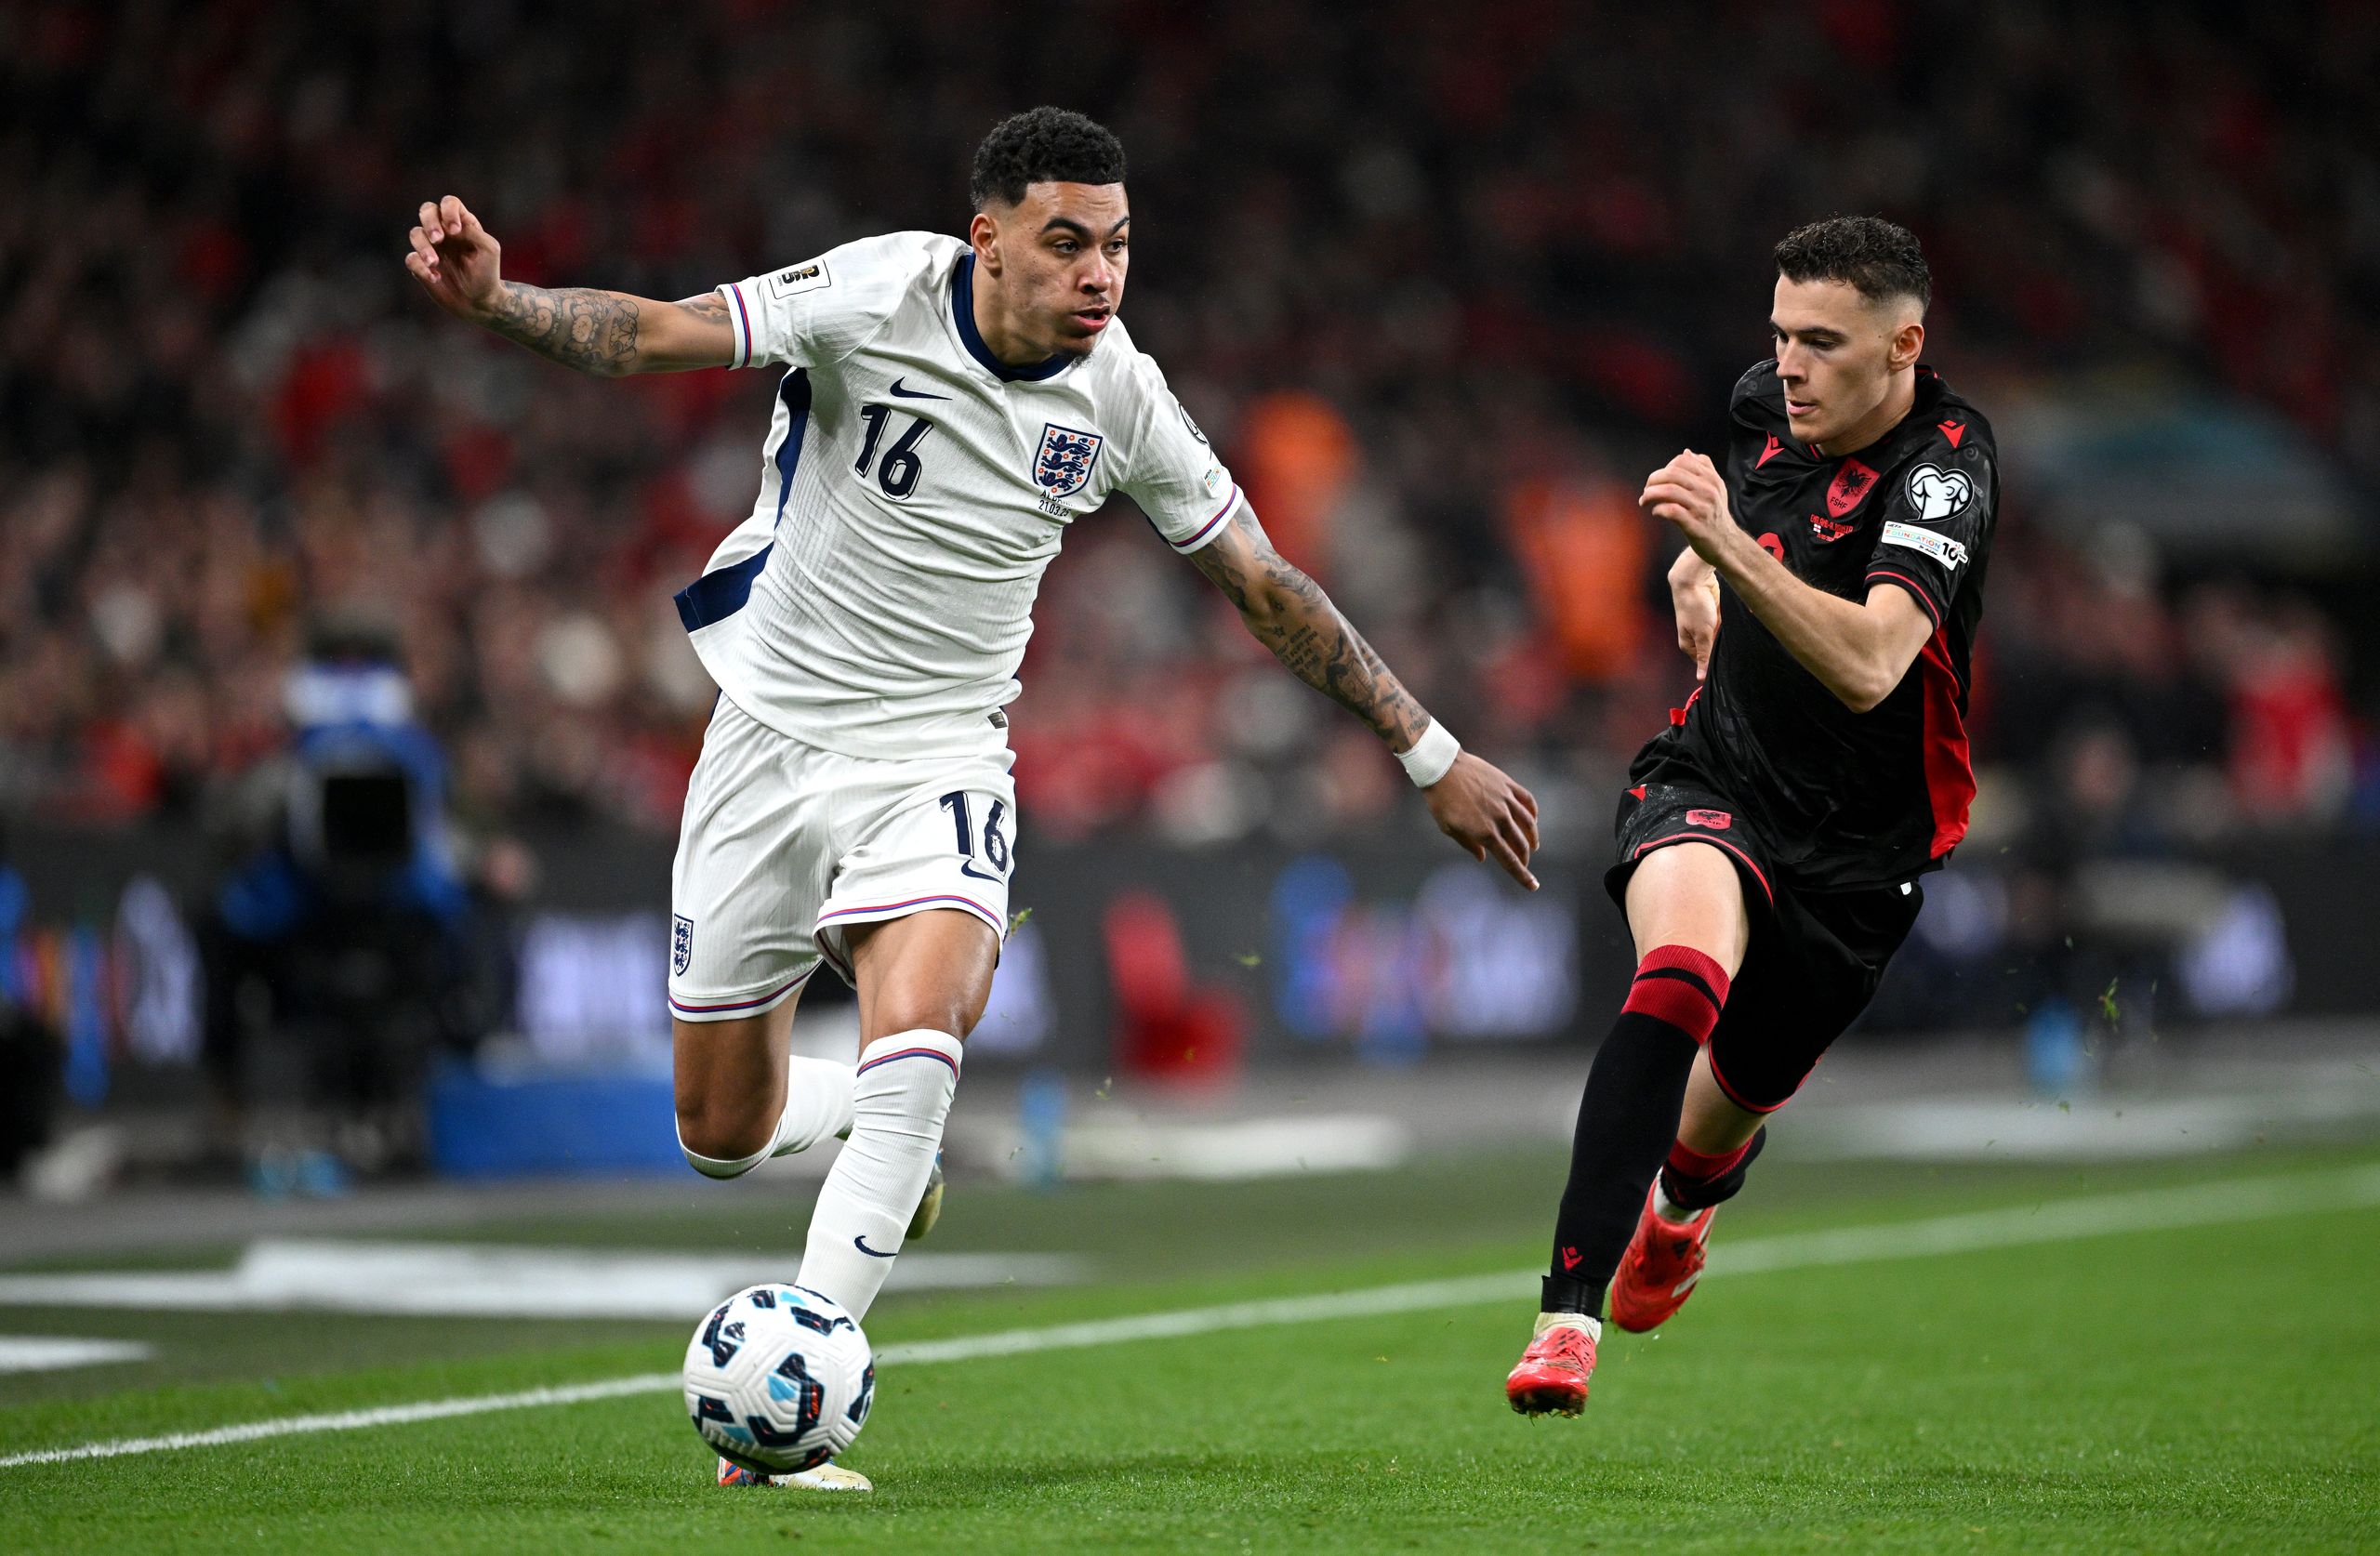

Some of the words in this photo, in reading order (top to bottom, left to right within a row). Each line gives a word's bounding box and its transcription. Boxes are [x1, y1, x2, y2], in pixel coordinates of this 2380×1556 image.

[855, 404, 934, 501] 16
[1038, 499, 1072, 517] 21.03.25
[1830, 496, 1848, 509] FSHF
[1885, 529, 1942, 549] FOUNDATION
[939, 790, 1010, 877] 16
